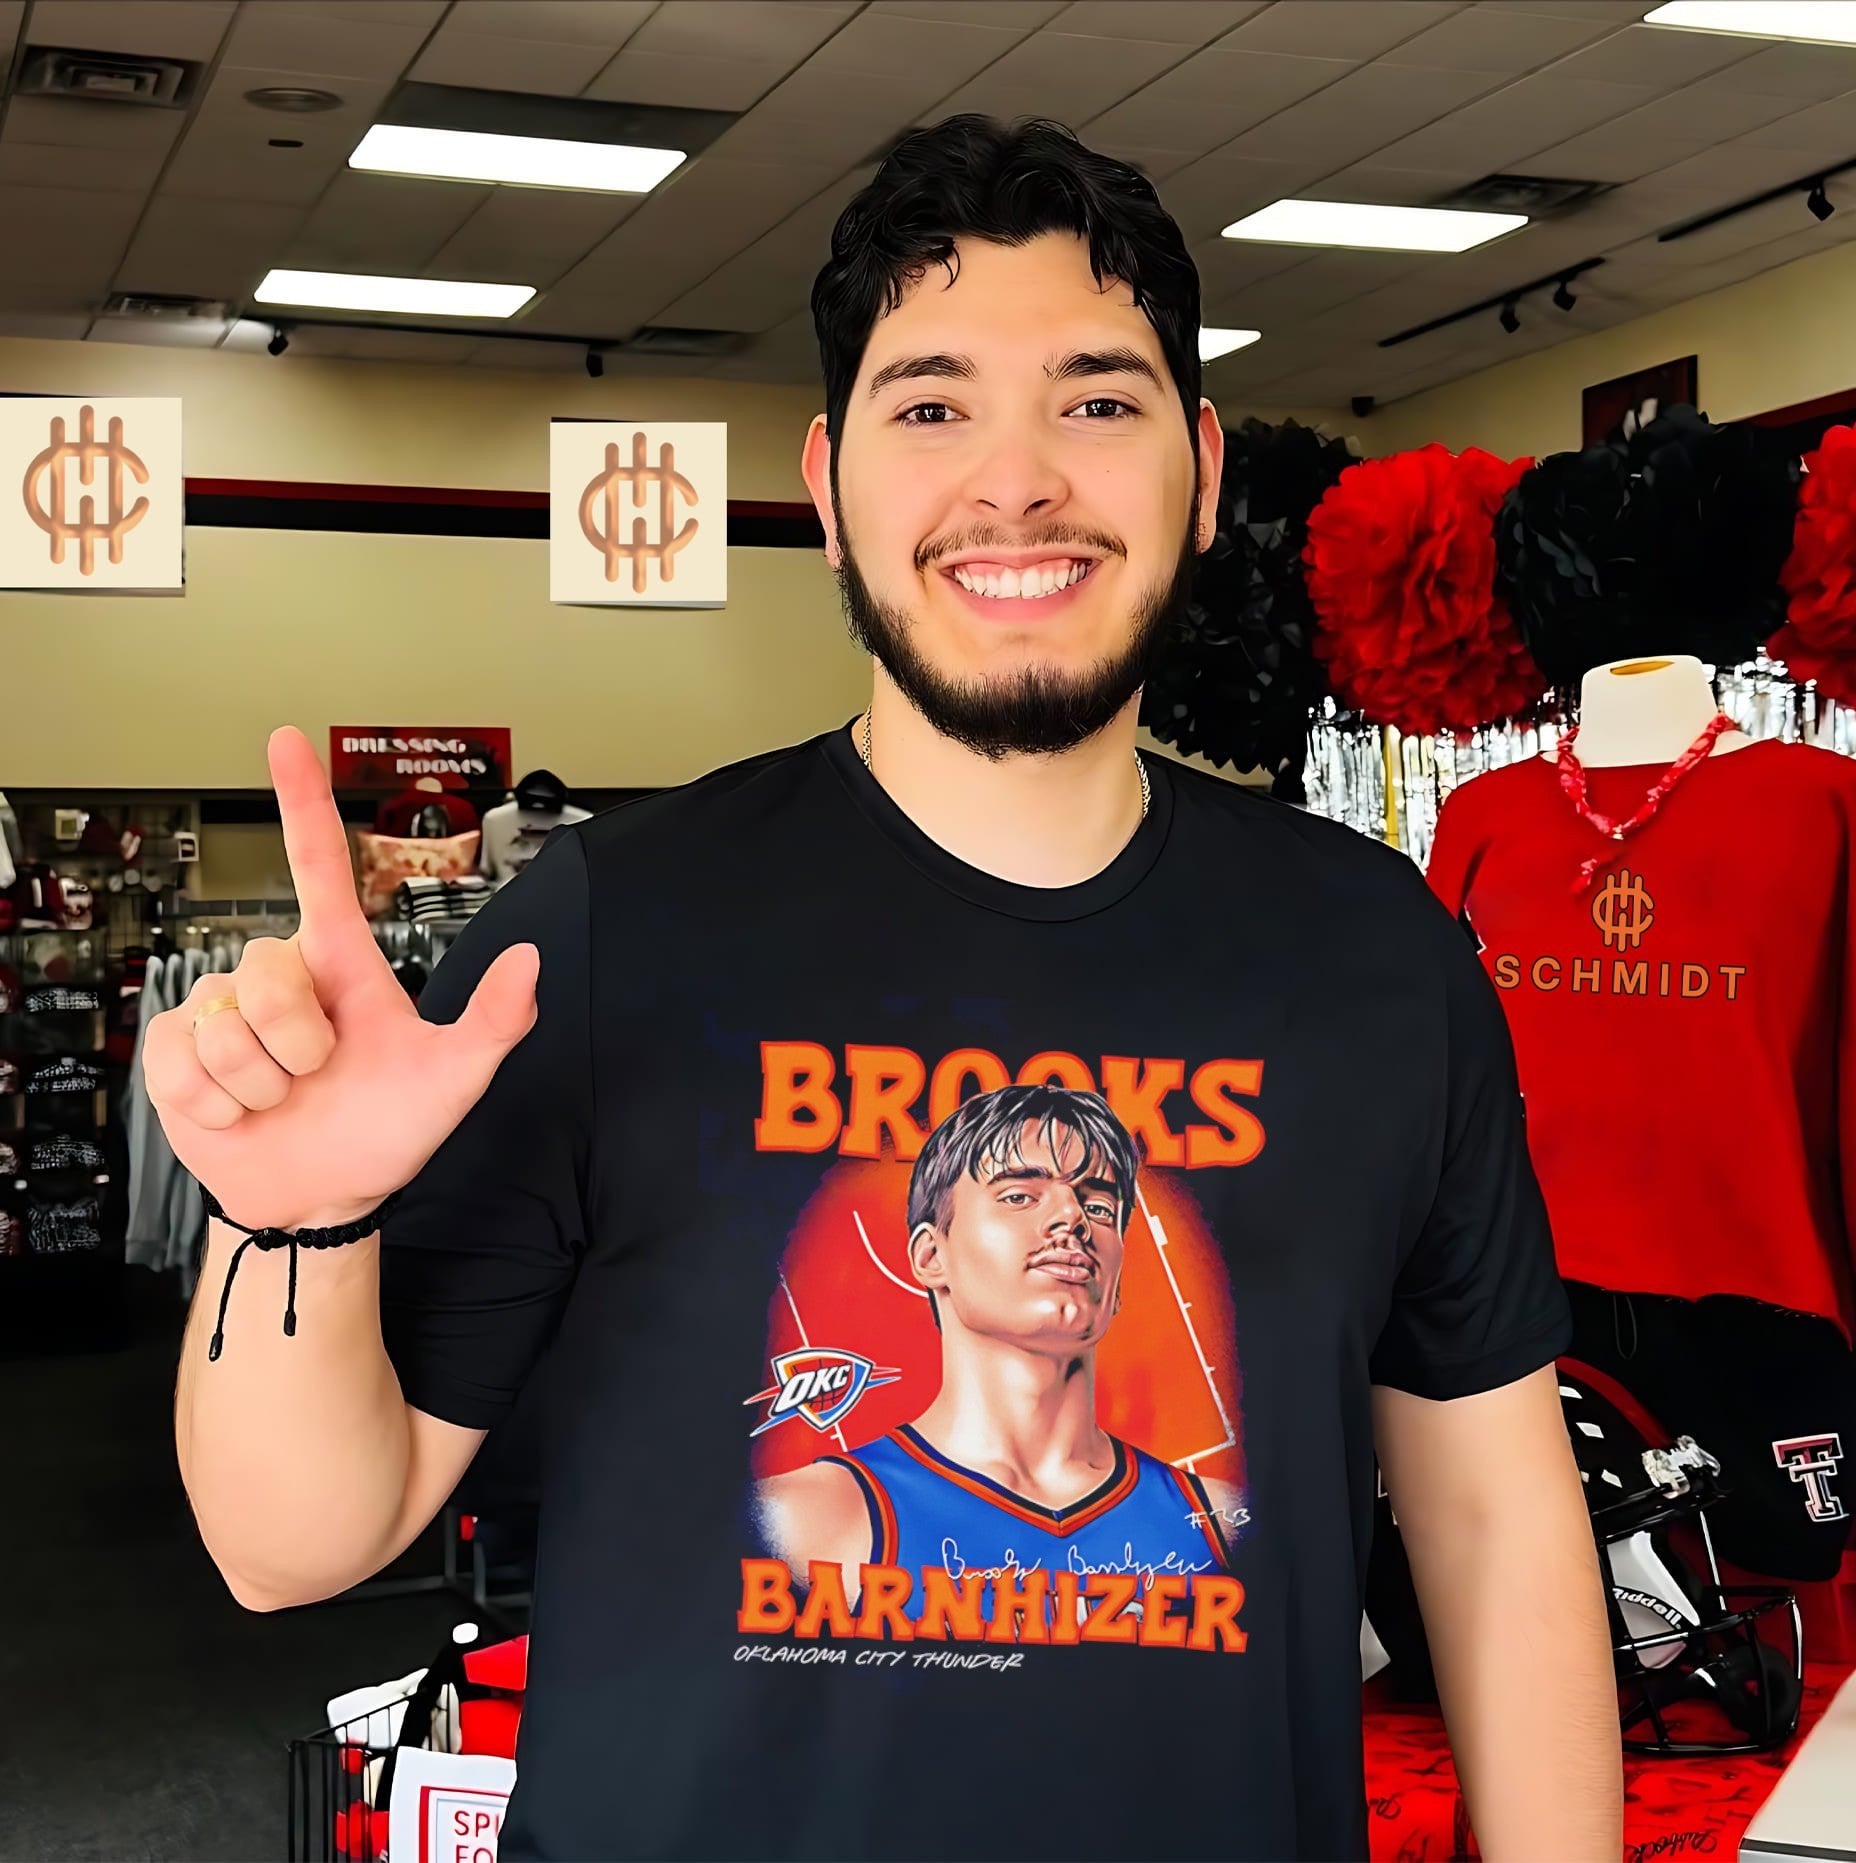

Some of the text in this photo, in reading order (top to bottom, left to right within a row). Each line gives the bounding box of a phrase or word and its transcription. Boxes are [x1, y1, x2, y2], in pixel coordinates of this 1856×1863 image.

[342, 737, 467, 753] DRESSING
[396, 758, 488, 775] ROOMS
[1494, 954, 1747, 1000] SCHMIDT
[774, 1364, 852, 1413] OKC
[1184, 1508, 1251, 1529] #23
[737, 1558, 1249, 1653] BARNHIZER
[733, 1645, 1025, 1672] OKLAHOMA CITY THUNDER
